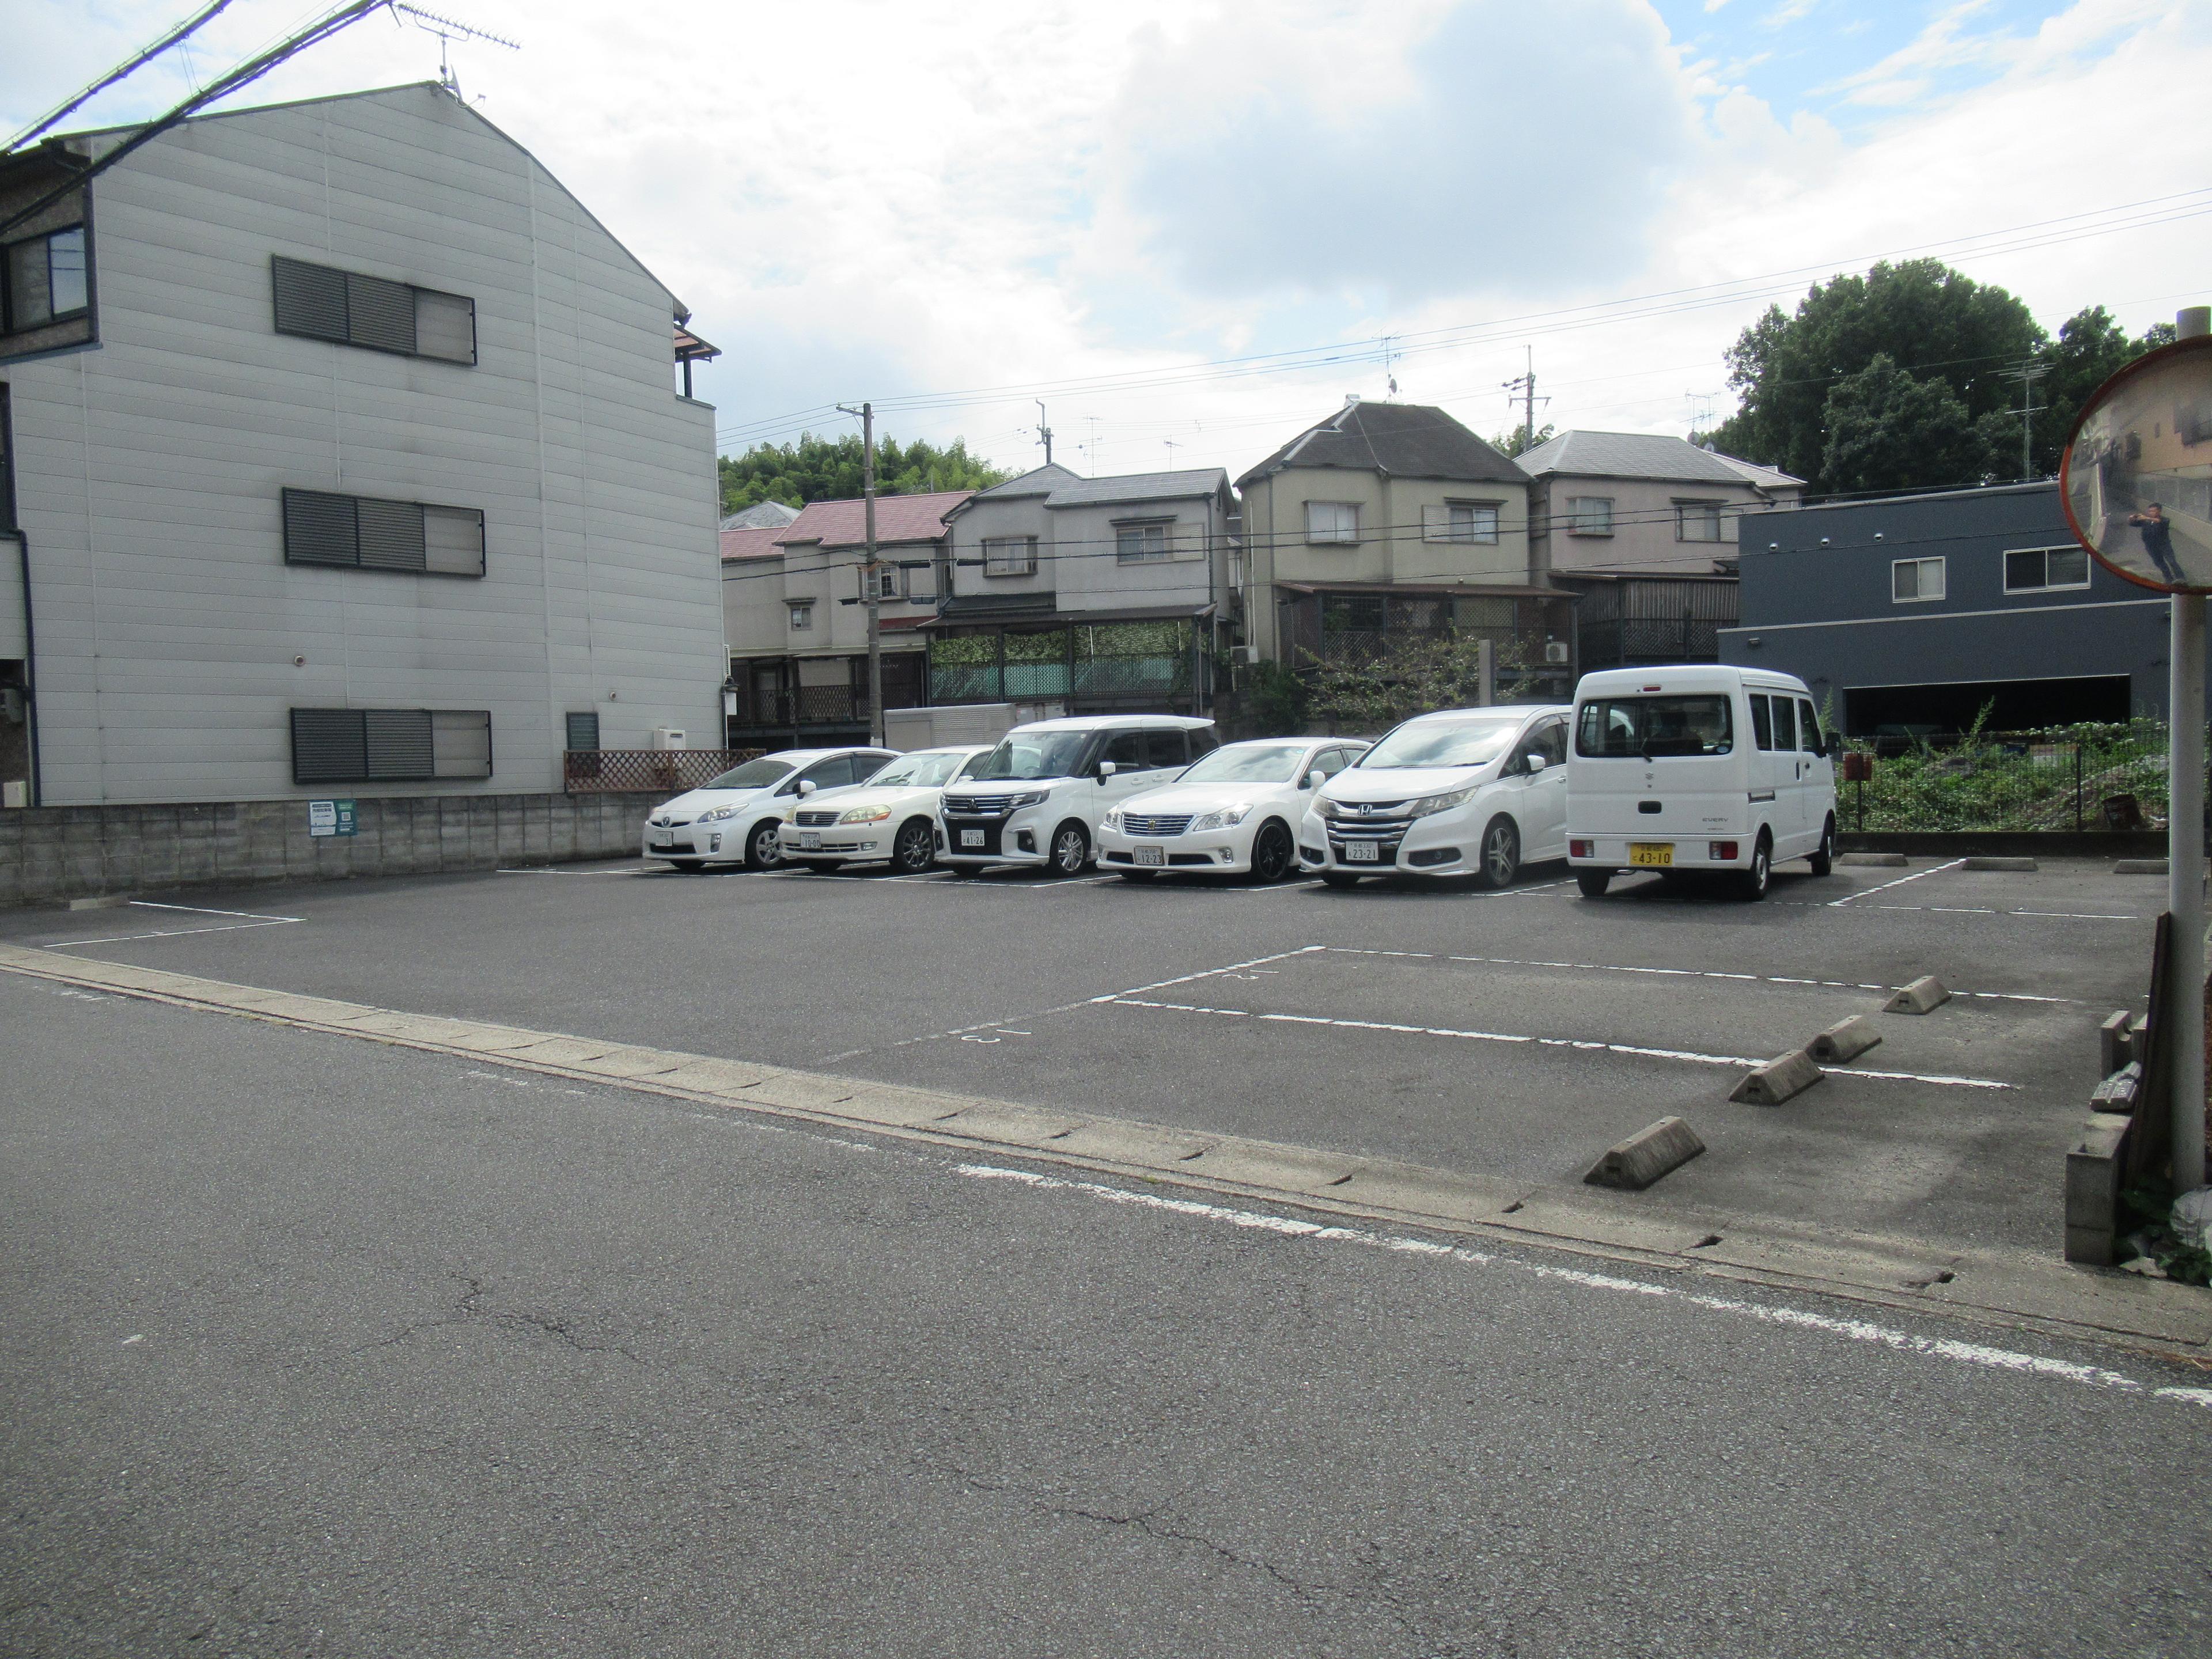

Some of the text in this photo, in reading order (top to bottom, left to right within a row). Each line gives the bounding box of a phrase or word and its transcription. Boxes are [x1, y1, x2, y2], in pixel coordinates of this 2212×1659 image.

[805, 839, 820, 847] 10-00
[967, 836, 983, 844] 41-26
[1142, 854, 1162, 863] 12-23
[1353, 849, 1376, 859] 23-21
[1639, 853, 1670, 863] 43-10
